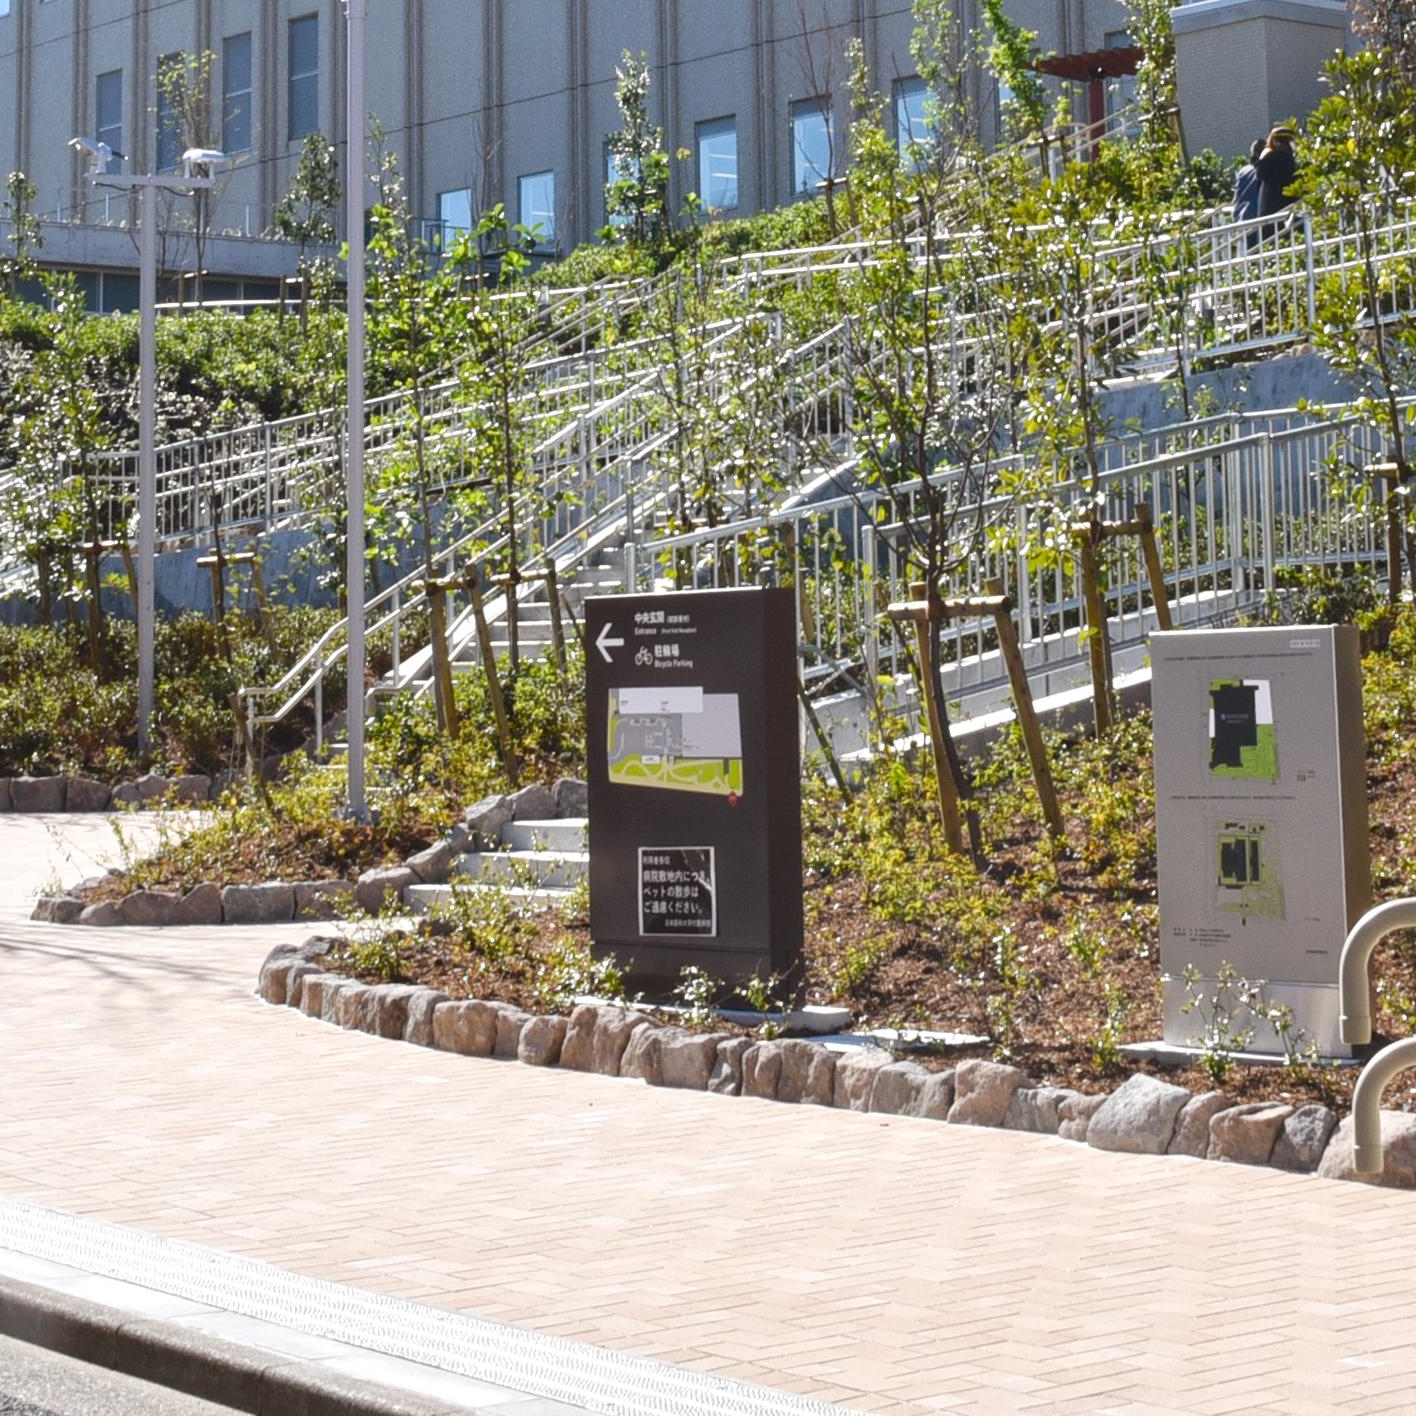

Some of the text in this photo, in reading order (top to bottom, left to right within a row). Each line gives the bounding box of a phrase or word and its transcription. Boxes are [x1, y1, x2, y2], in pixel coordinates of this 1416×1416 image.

[634, 610, 665, 625] 中央玄関
[654, 644, 680, 658] 駐輪場
[654, 658, 694, 669] Bicycle Parking
[643, 885, 700, 898] ペットの散歩は
